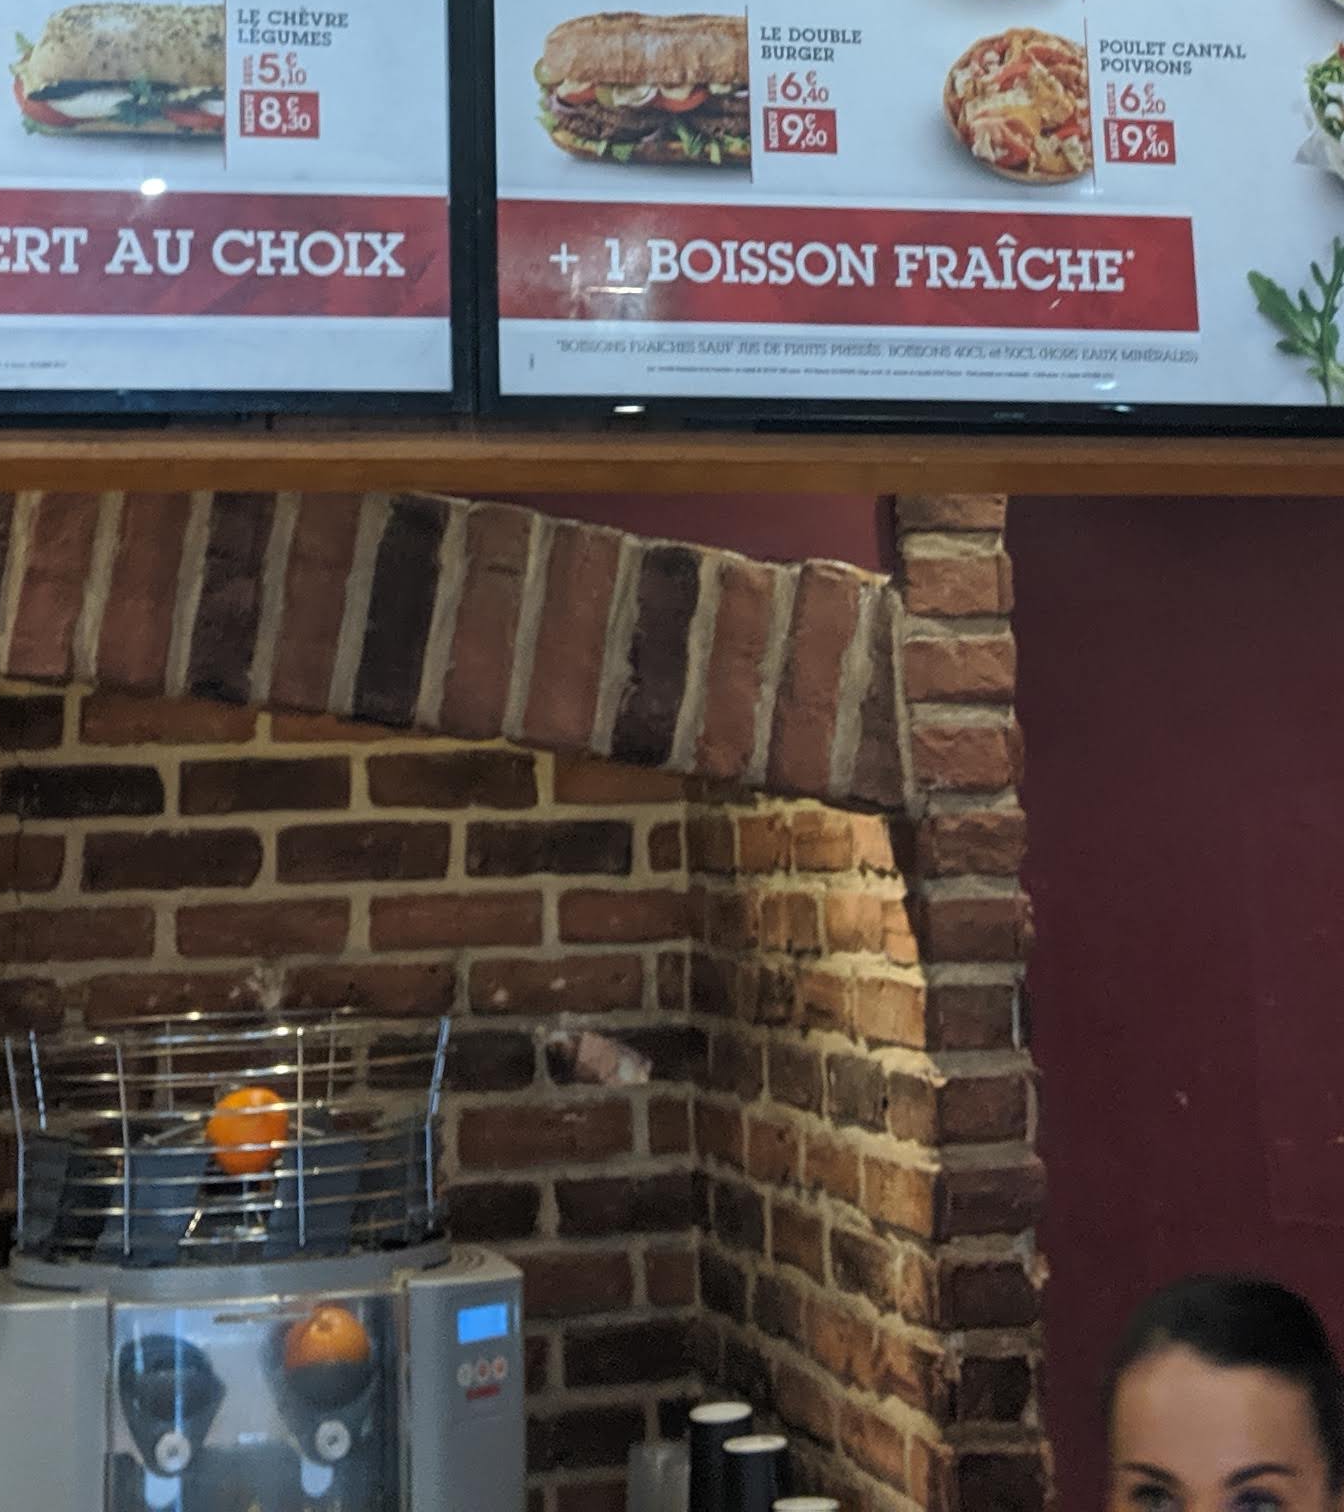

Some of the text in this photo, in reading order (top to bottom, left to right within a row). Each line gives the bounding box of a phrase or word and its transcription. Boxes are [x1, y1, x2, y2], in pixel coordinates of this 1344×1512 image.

[237, 6, 349, 28] LE CHÈVRE
[760, 27, 862, 44] LE DOUBLE
[761, 45, 834, 62] BURGER
[1099, 39, 1247, 59] POULET CANTAL
[1100, 58, 1192, 75] POIVRONS
[105, 229, 195, 275] AU
[211, 230, 406, 278] CHOIX
[604, 238, 625, 281] 1
[646, 238, 877, 287] BOISSON
